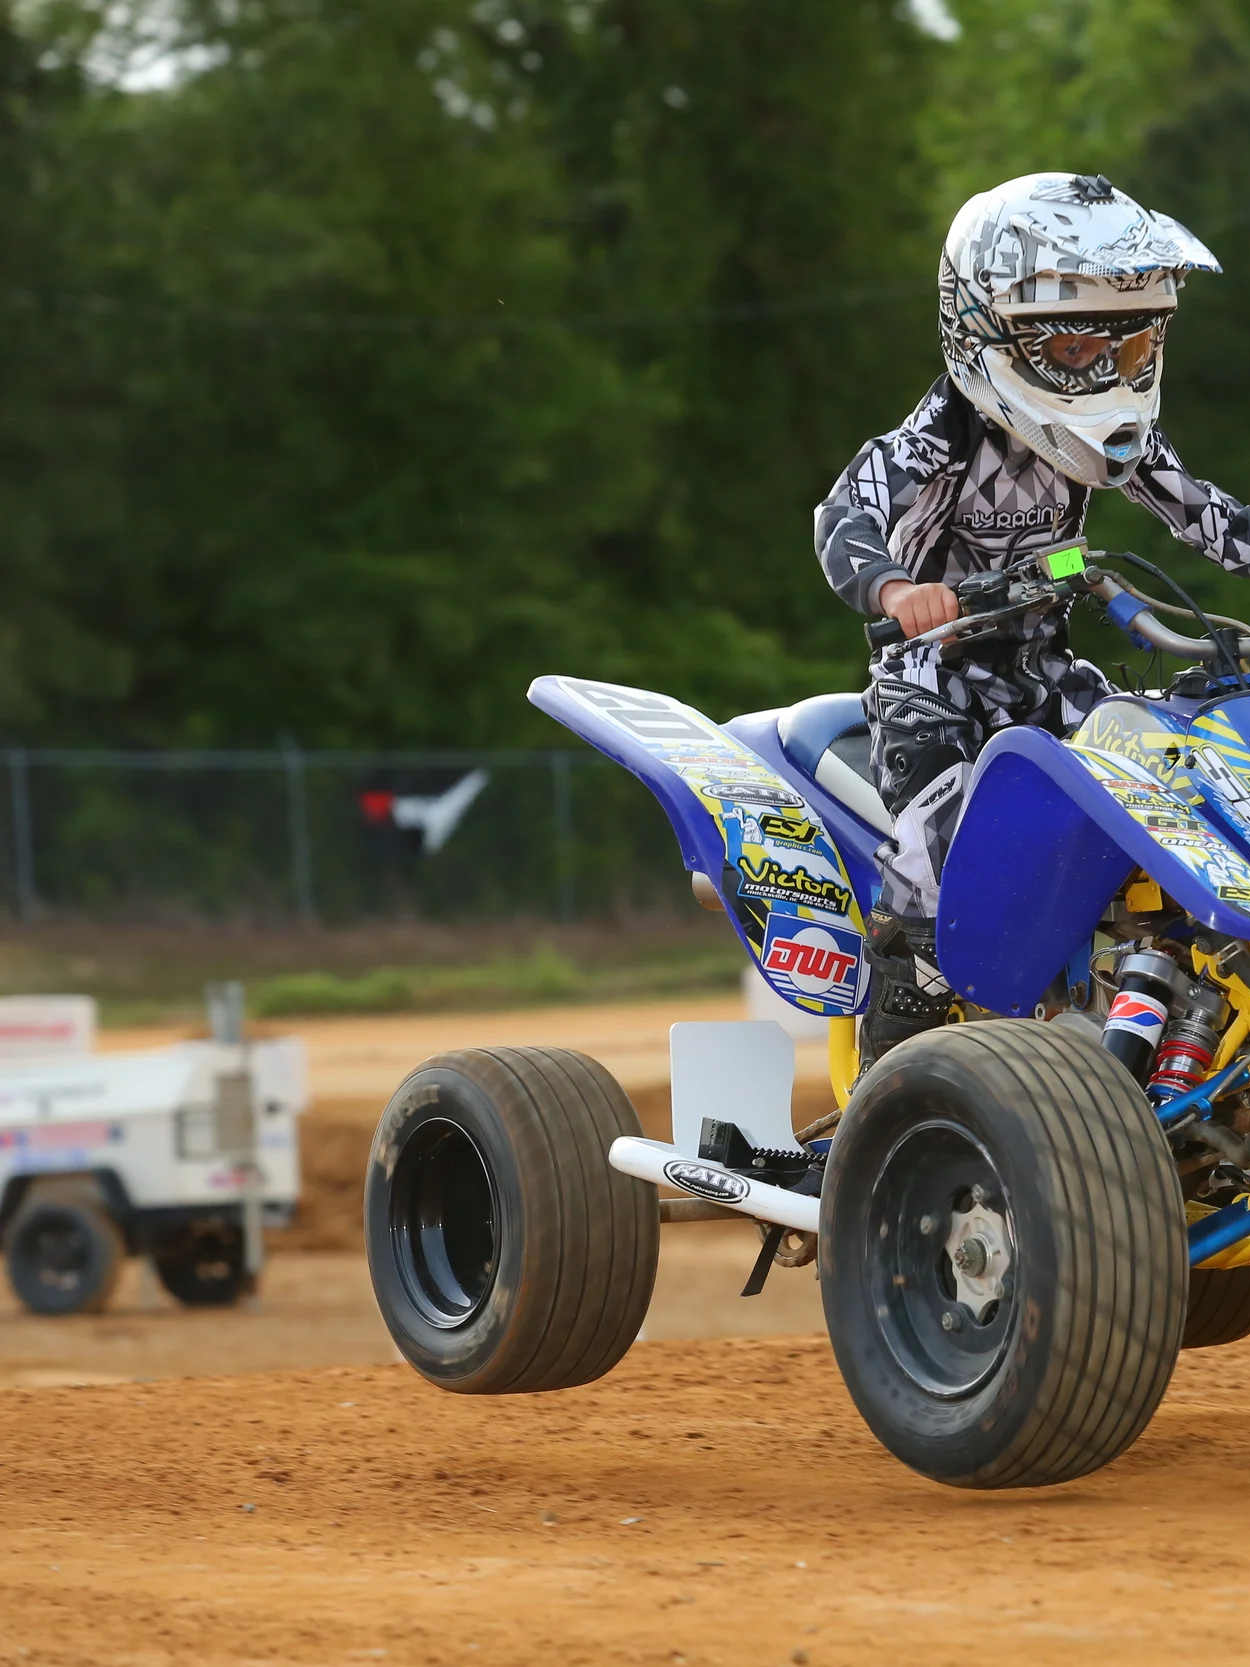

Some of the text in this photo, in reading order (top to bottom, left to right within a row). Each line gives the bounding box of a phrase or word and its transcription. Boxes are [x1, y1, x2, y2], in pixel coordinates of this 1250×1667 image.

[1114, 793, 1191, 815] Victory
[759, 815, 817, 843] ESJ
[1145, 815, 1207, 831] GT
[775, 840, 823, 856] graphics.com
[739, 858, 849, 912] Victory
[744, 883, 837, 907] motorsports
[767, 940, 856, 983] DWT
[671, 1163, 742, 1196] RATH
